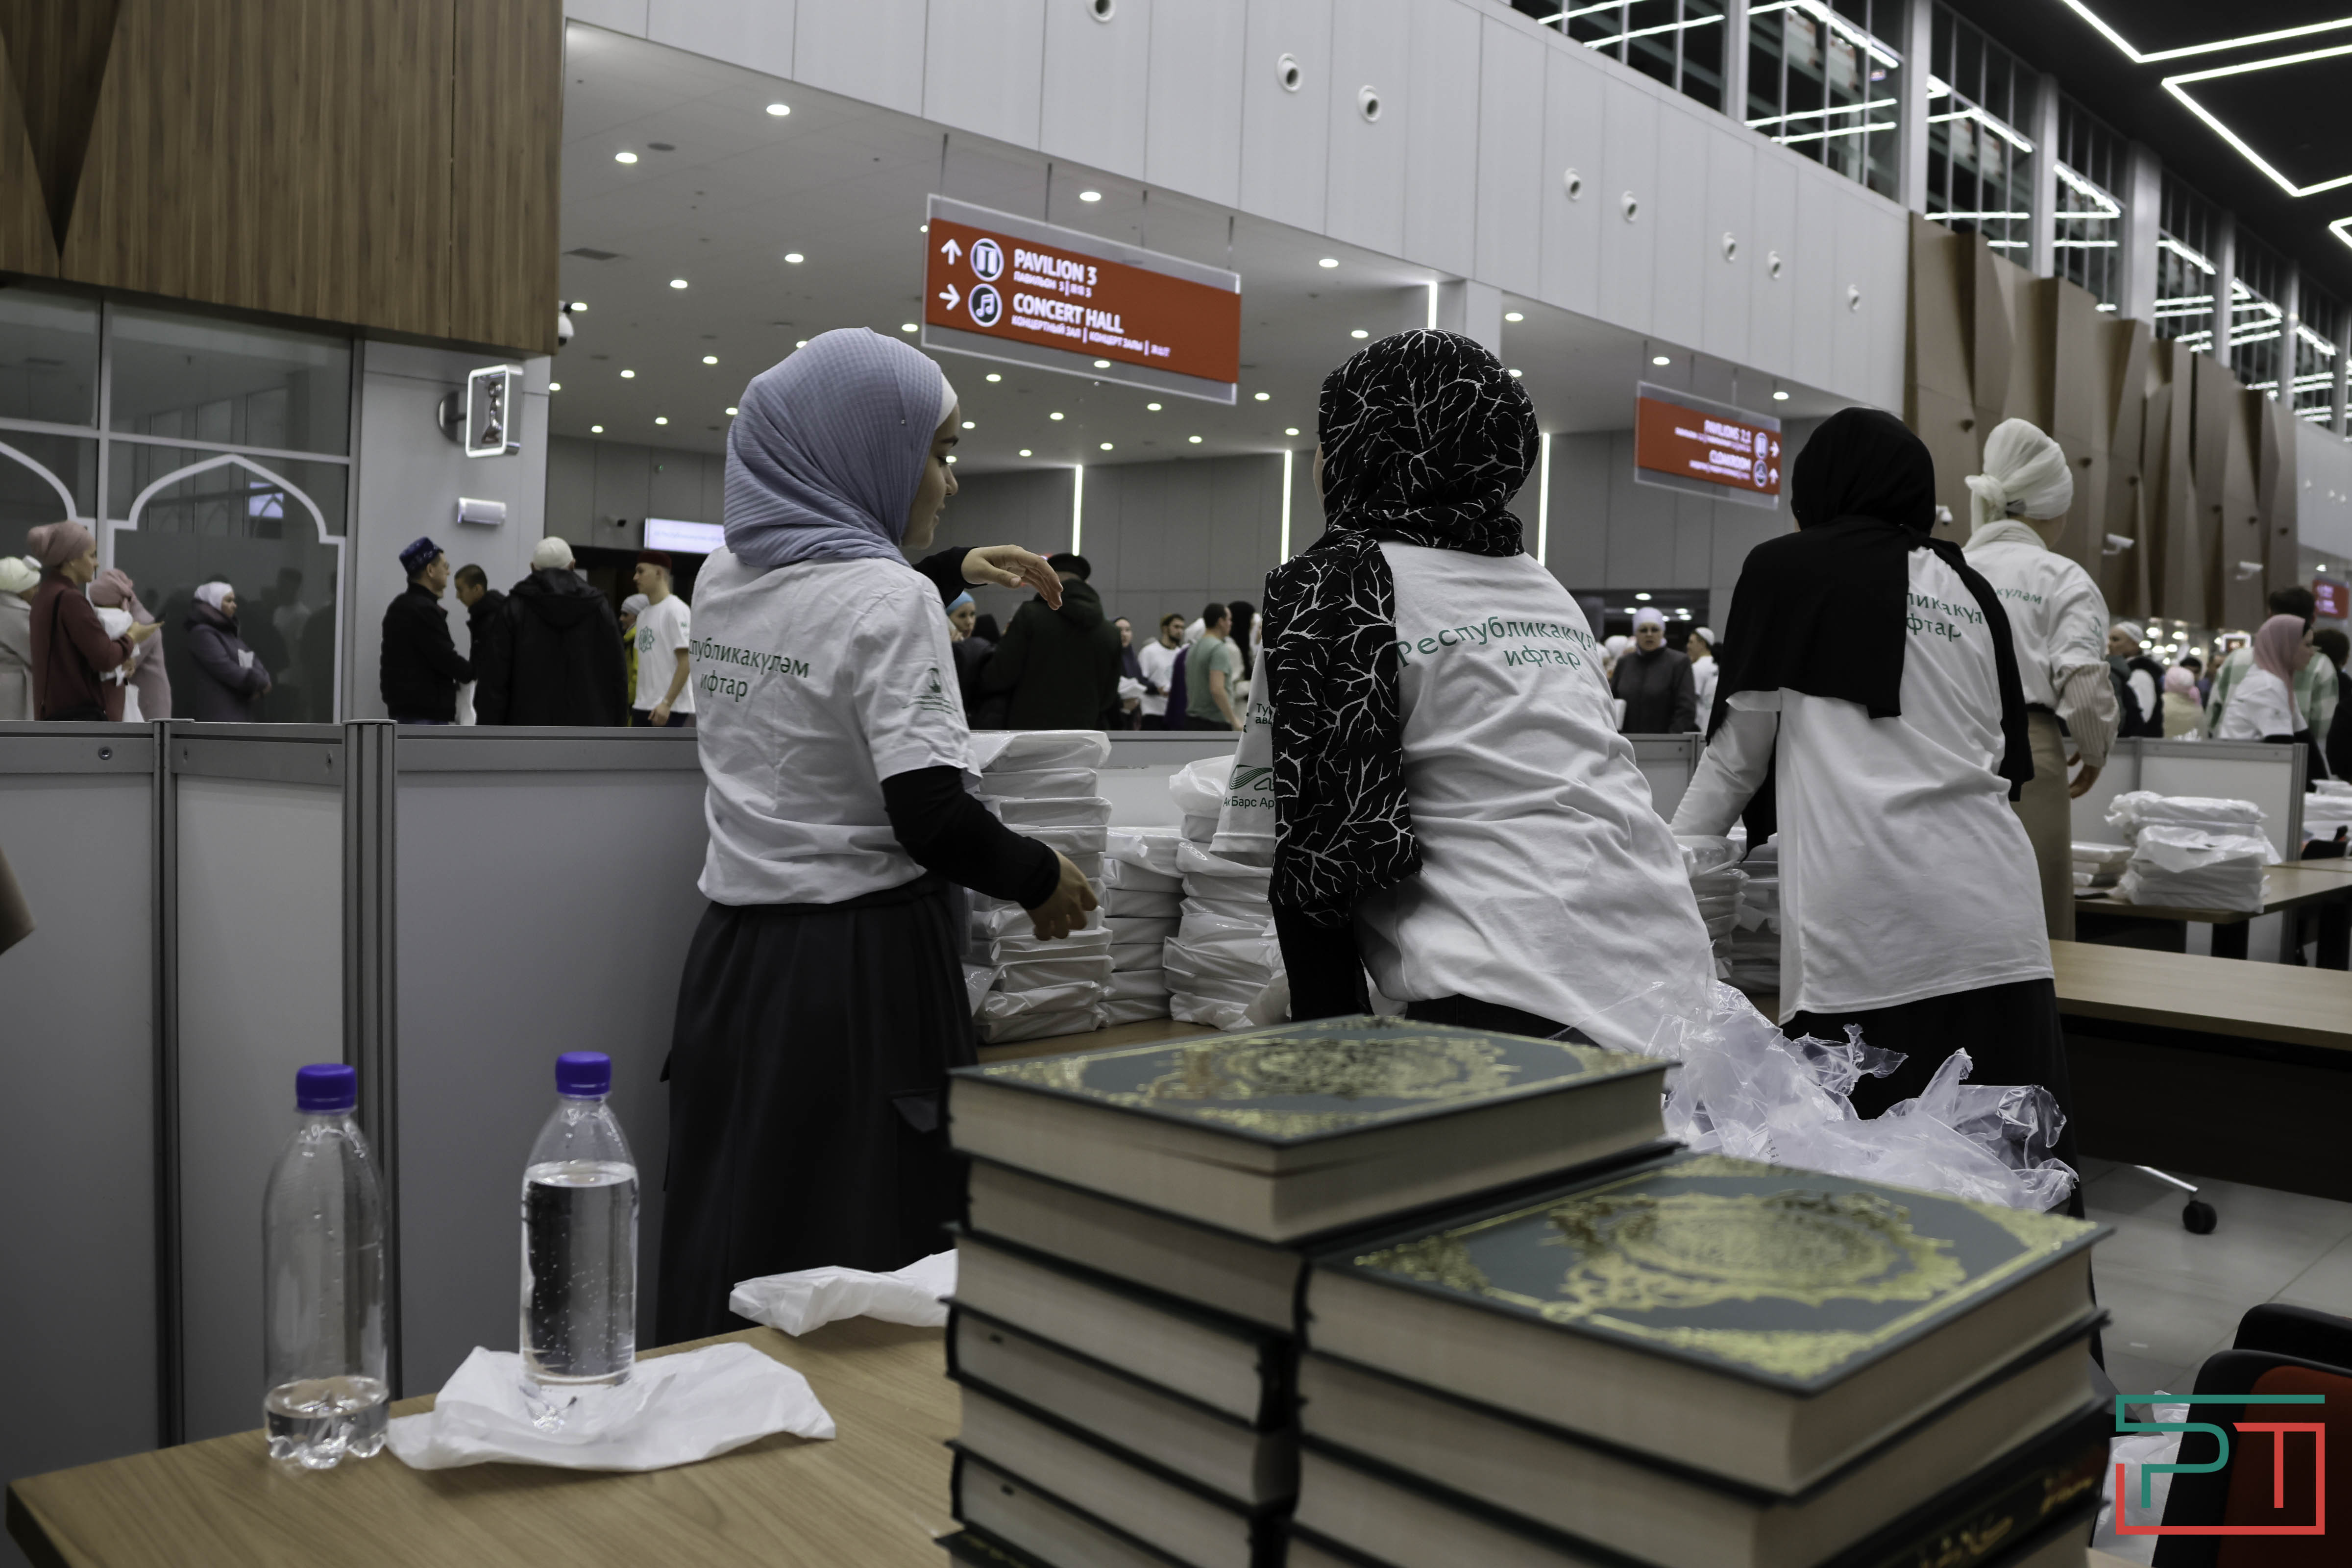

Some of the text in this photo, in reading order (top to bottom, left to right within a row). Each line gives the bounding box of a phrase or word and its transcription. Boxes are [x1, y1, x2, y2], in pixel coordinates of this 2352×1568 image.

[1014, 248, 1097, 285] PAVILION 3
[1011, 315, 1065, 335] КОНЦЕРТНЫЙ
[1013, 293, 1124, 334] CONCERT HALL
[1396, 616, 1597, 667] Республикакүл
[1503, 645, 1581, 670] ифтар
[700, 670, 748, 702] ифтар
[1231, 796, 1257, 809] Барс
